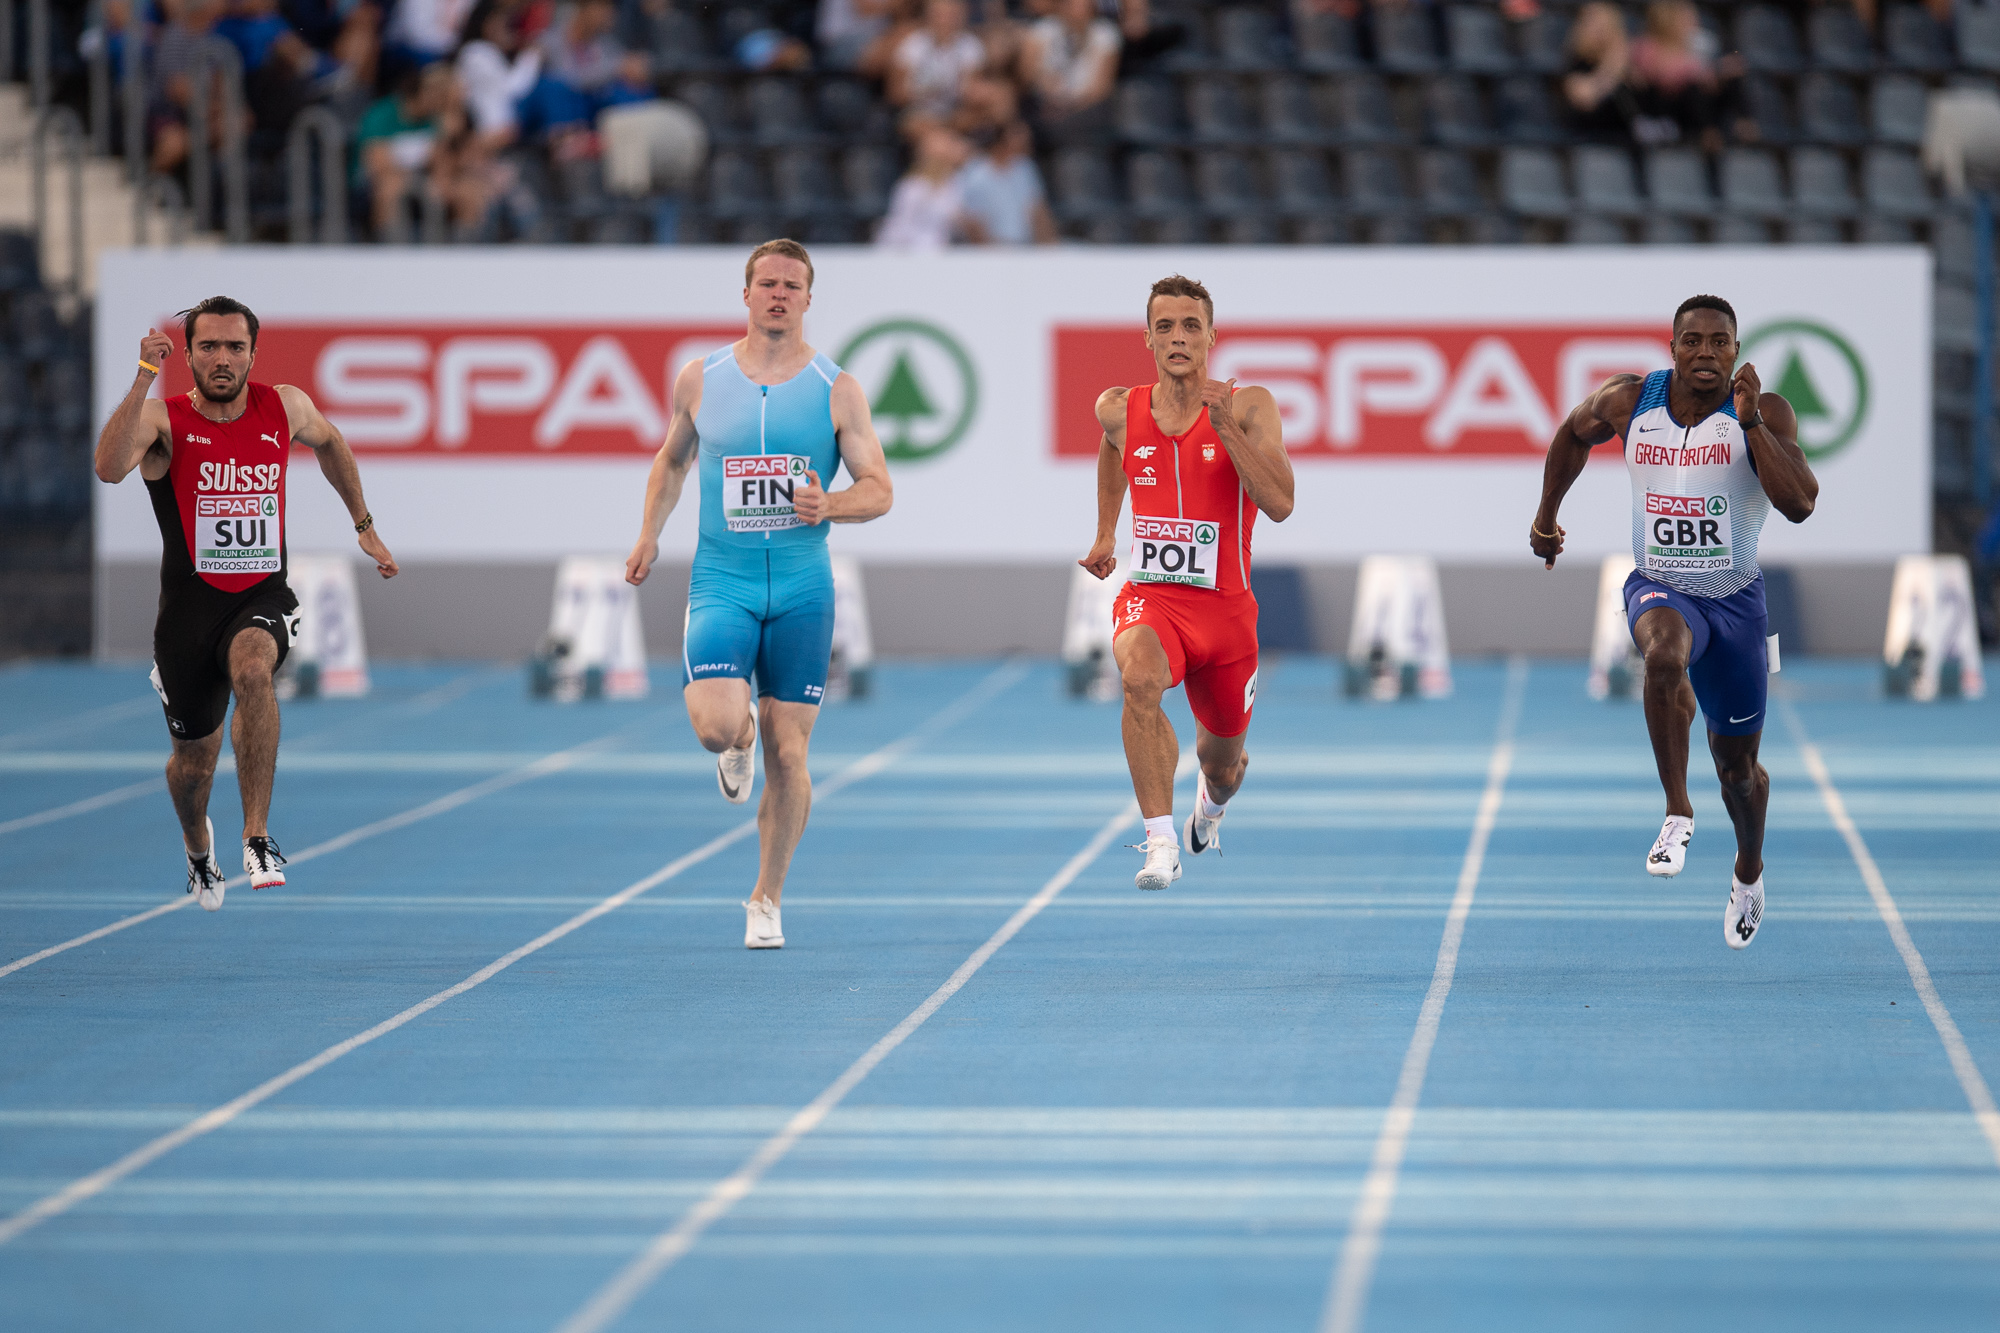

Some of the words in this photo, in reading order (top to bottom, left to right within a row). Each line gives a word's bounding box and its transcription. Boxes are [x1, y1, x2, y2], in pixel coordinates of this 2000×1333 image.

[196, 435, 212, 445] UBS
[1133, 445, 1157, 459] 4F
[1635, 442, 1679, 466] GREAT
[1679, 443, 1731, 466] BRITAIN
[727, 459, 786, 475] SPAR
[742, 478, 794, 506] FIN
[199, 499, 260, 515] SPAR
[745, 508, 764, 516] RUN
[765, 507, 792, 515] CLEAN
[1647, 495, 1704, 514] SPAR
[214, 519, 267, 548] SUI
[1136, 521, 1192, 540] SPAR
[1653, 518, 1723, 546] GBR
[1141, 542, 1205, 574] POL
[1662, 548, 1681, 556] RUN
[200, 560, 260, 571] BYDGOSZCZ
[1648, 557, 1706, 569] BYDGOSZCZ
[1708, 558, 1731, 569] 2019
[1148, 573, 1165, 581] RUN
[693, 663, 731, 673] CRAFT
